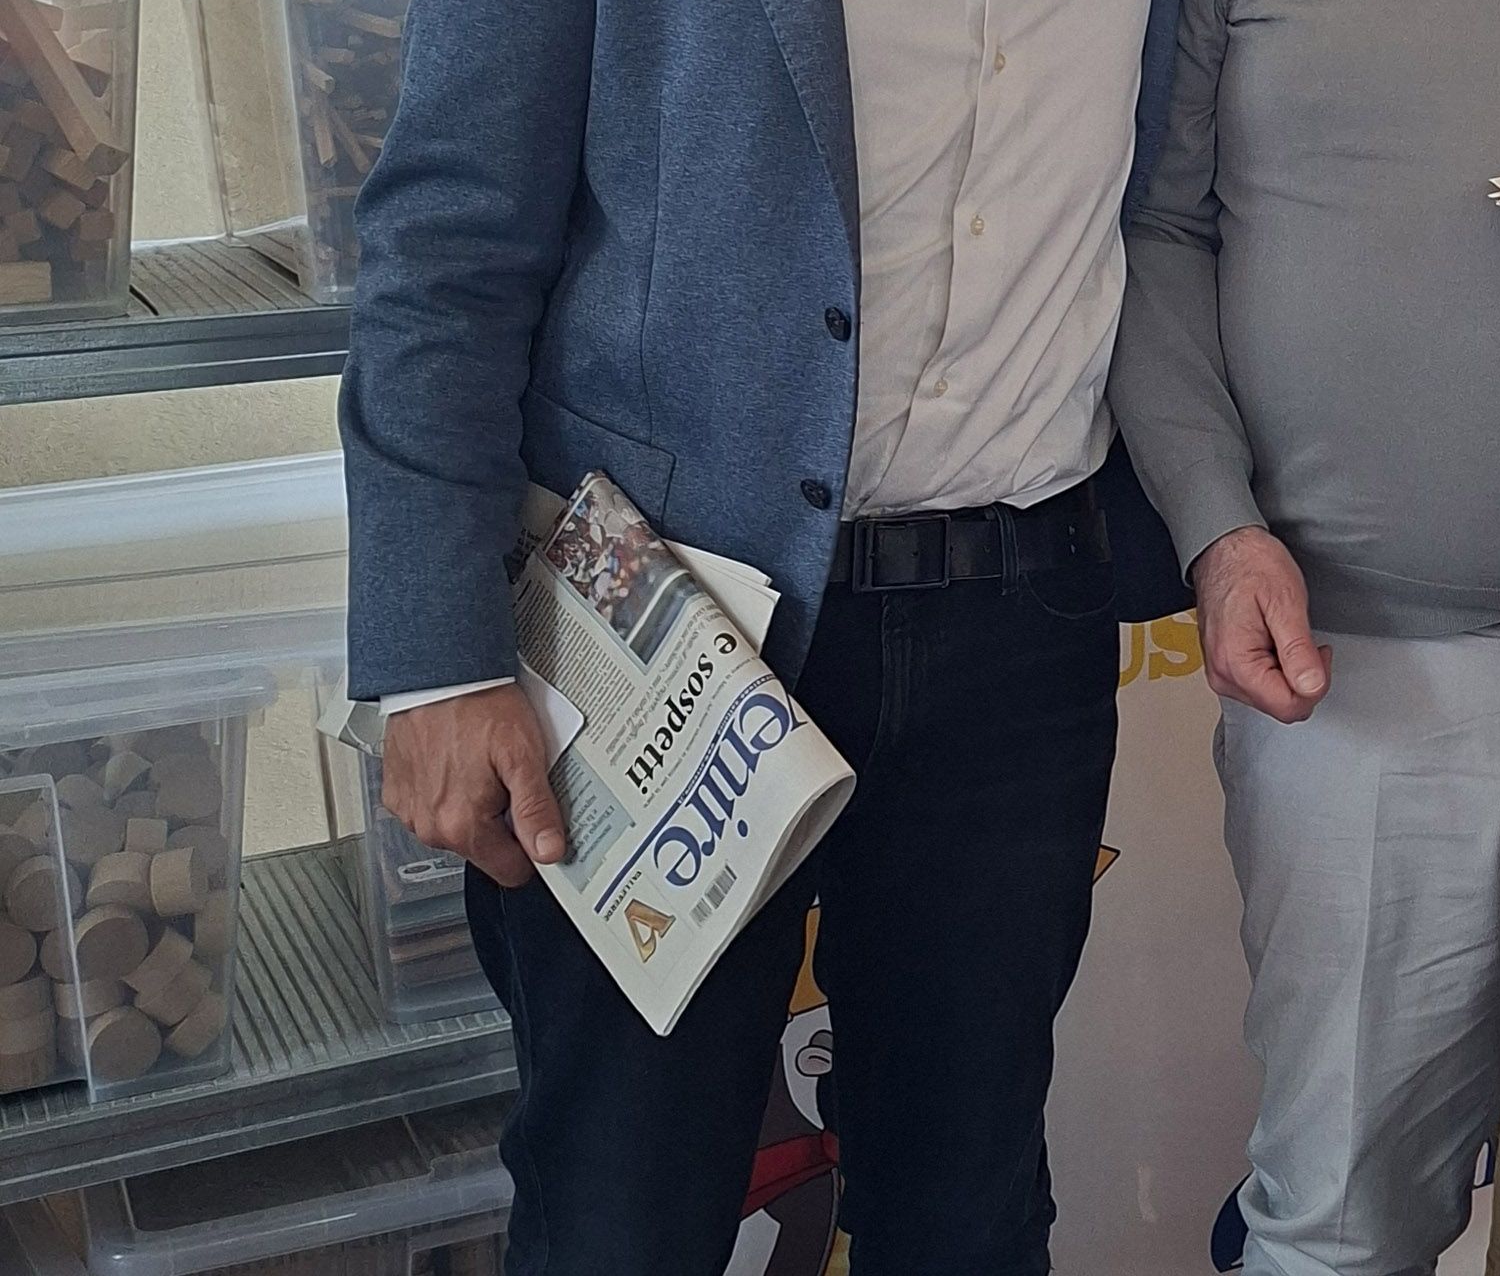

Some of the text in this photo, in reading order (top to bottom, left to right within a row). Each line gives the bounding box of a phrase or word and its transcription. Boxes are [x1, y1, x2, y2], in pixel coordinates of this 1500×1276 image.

[713, 633, 738, 655] e
[625, 653, 714, 795] sospetti
[654, 692, 808, 887] enire
